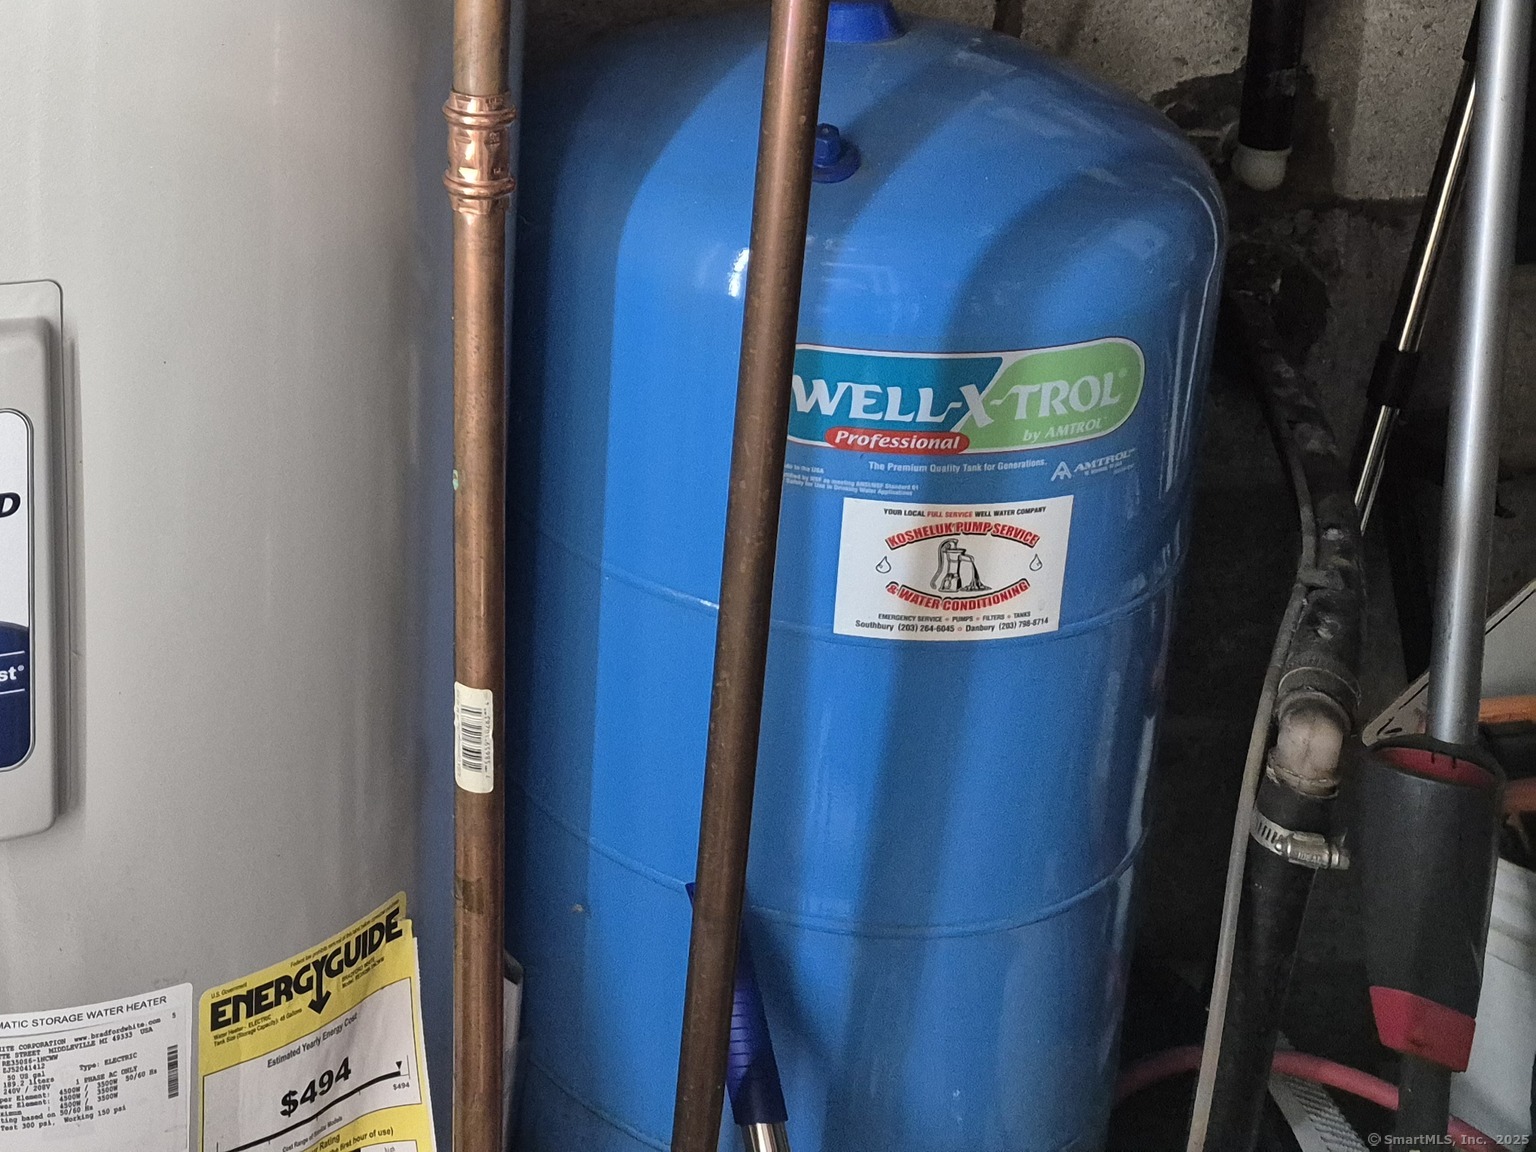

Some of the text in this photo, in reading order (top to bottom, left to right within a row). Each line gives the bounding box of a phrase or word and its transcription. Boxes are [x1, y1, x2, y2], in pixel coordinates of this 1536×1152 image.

[792, 371, 1122, 428] WELL-X-TROL
[833, 429, 961, 450] Professional
[1022, 418, 1104, 444] by AMTROL
[868, 459, 1047, 474] The Premium Quality Tank for Generations.
[1073, 450, 1131, 472] AMTROL
[883, 508, 903, 516] YOUR
[903, 509, 926, 517] LOCAL
[926, 510, 944, 518] FULL
[974, 510, 992, 518] WELL
[993, 508, 1015, 517] WATER
[1016, 506, 1047, 516] COMPANY
[885, 521, 1041, 551] KOSHELUK PUMP SERVICE
[886, 578, 1031, 612] & WATER CONDITIONING
[855, 617, 1049, 633] Southbury (203) 264-6045 Danbury (203) 798-8714
[878, 613, 916, 622] EMERGENCY
[917, 615, 943, 623] SERVICE
[982, 613, 1005, 621] FILTERS
[1013, 611, 1031, 619] TANKS
[211, 907, 403, 1032] ENERGYGUIDE
[221, 981, 248, 996] Government
[31, 1013, 84, 1028] STORAGE
[86, 1005, 124, 1020] WATER
[126, 995, 168, 1012] HEATER
[248, 1014, 272, 1028] ELECTRIC
[14, 1049, 41, 1058] STREET
[49, 1041, 96, 1054] MIDDLEVILLE
[140, 1026, 154, 1035] USA
[18, 1038, 66, 1051] CORPORATION
[73, 1018, 161, 1042] www.bradfordwhite.com
[267, 1012, 358, 1068] Estimated Yearly Energy Cost
[104, 1052, 138, 1066] ELECTRIC
[32, 1071, 46, 1081] gal
[84, 1065, 138, 1084] PHASE ONLY
[280, 1056, 352, 1118] $494
[392, 1082, 410, 1091] $494
[0, 1104, 126, 1132] Test Working psi
[21, 1113, 44, 1122] based
[319, 1133, 341, 1150] Rating
[352, 1126, 394, 1144] hour of use)
